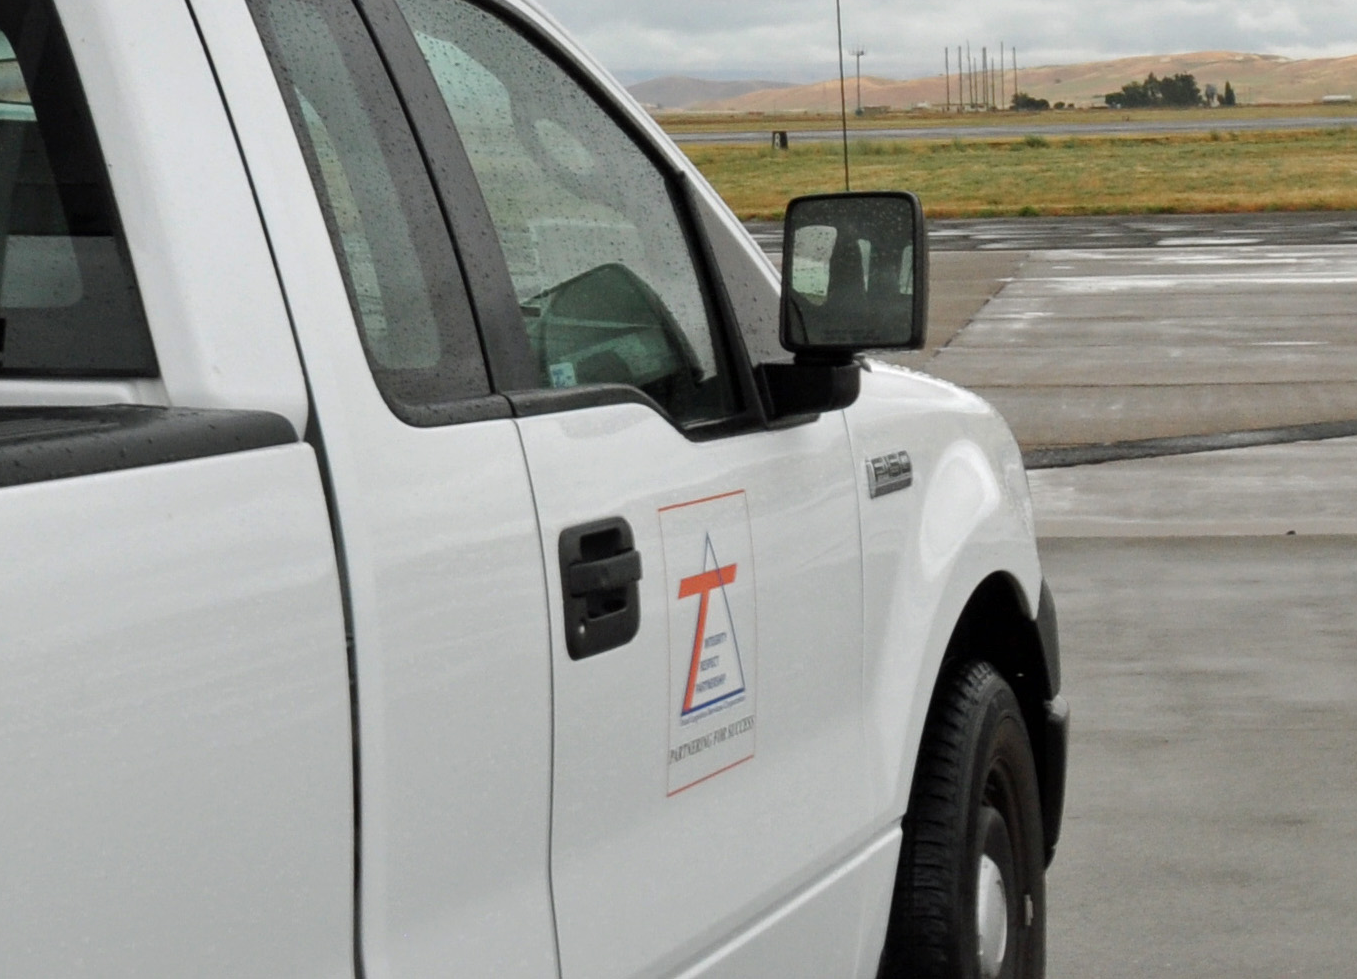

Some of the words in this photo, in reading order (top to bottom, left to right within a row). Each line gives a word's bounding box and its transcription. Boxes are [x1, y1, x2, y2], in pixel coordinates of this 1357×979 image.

[667, 732, 713, 765] PARTNERING
[713, 726, 728, 746] FOR
[728, 714, 755, 739] SUCCESS
